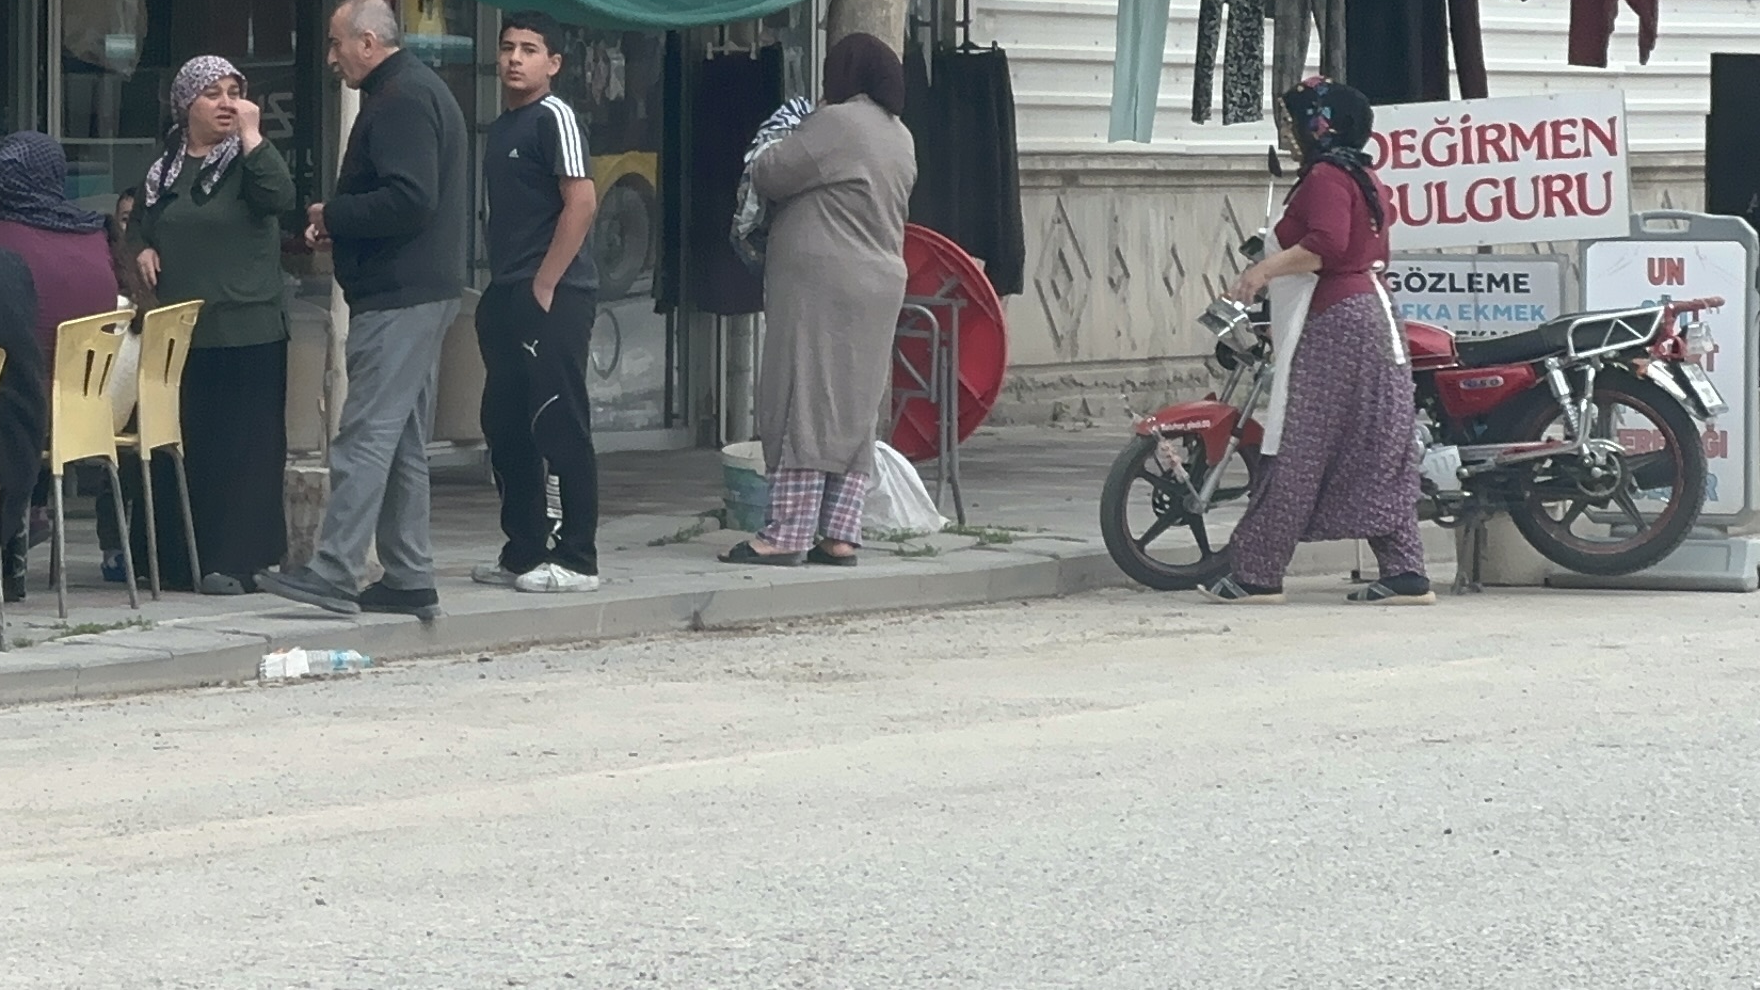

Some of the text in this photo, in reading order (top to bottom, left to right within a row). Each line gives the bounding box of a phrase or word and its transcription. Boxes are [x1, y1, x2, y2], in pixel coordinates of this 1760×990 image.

[1385, 266, 1531, 294] GÖZLEME
[1647, 257, 1685, 286] UN
[1401, 303, 1547, 321] FKA EKMEK
